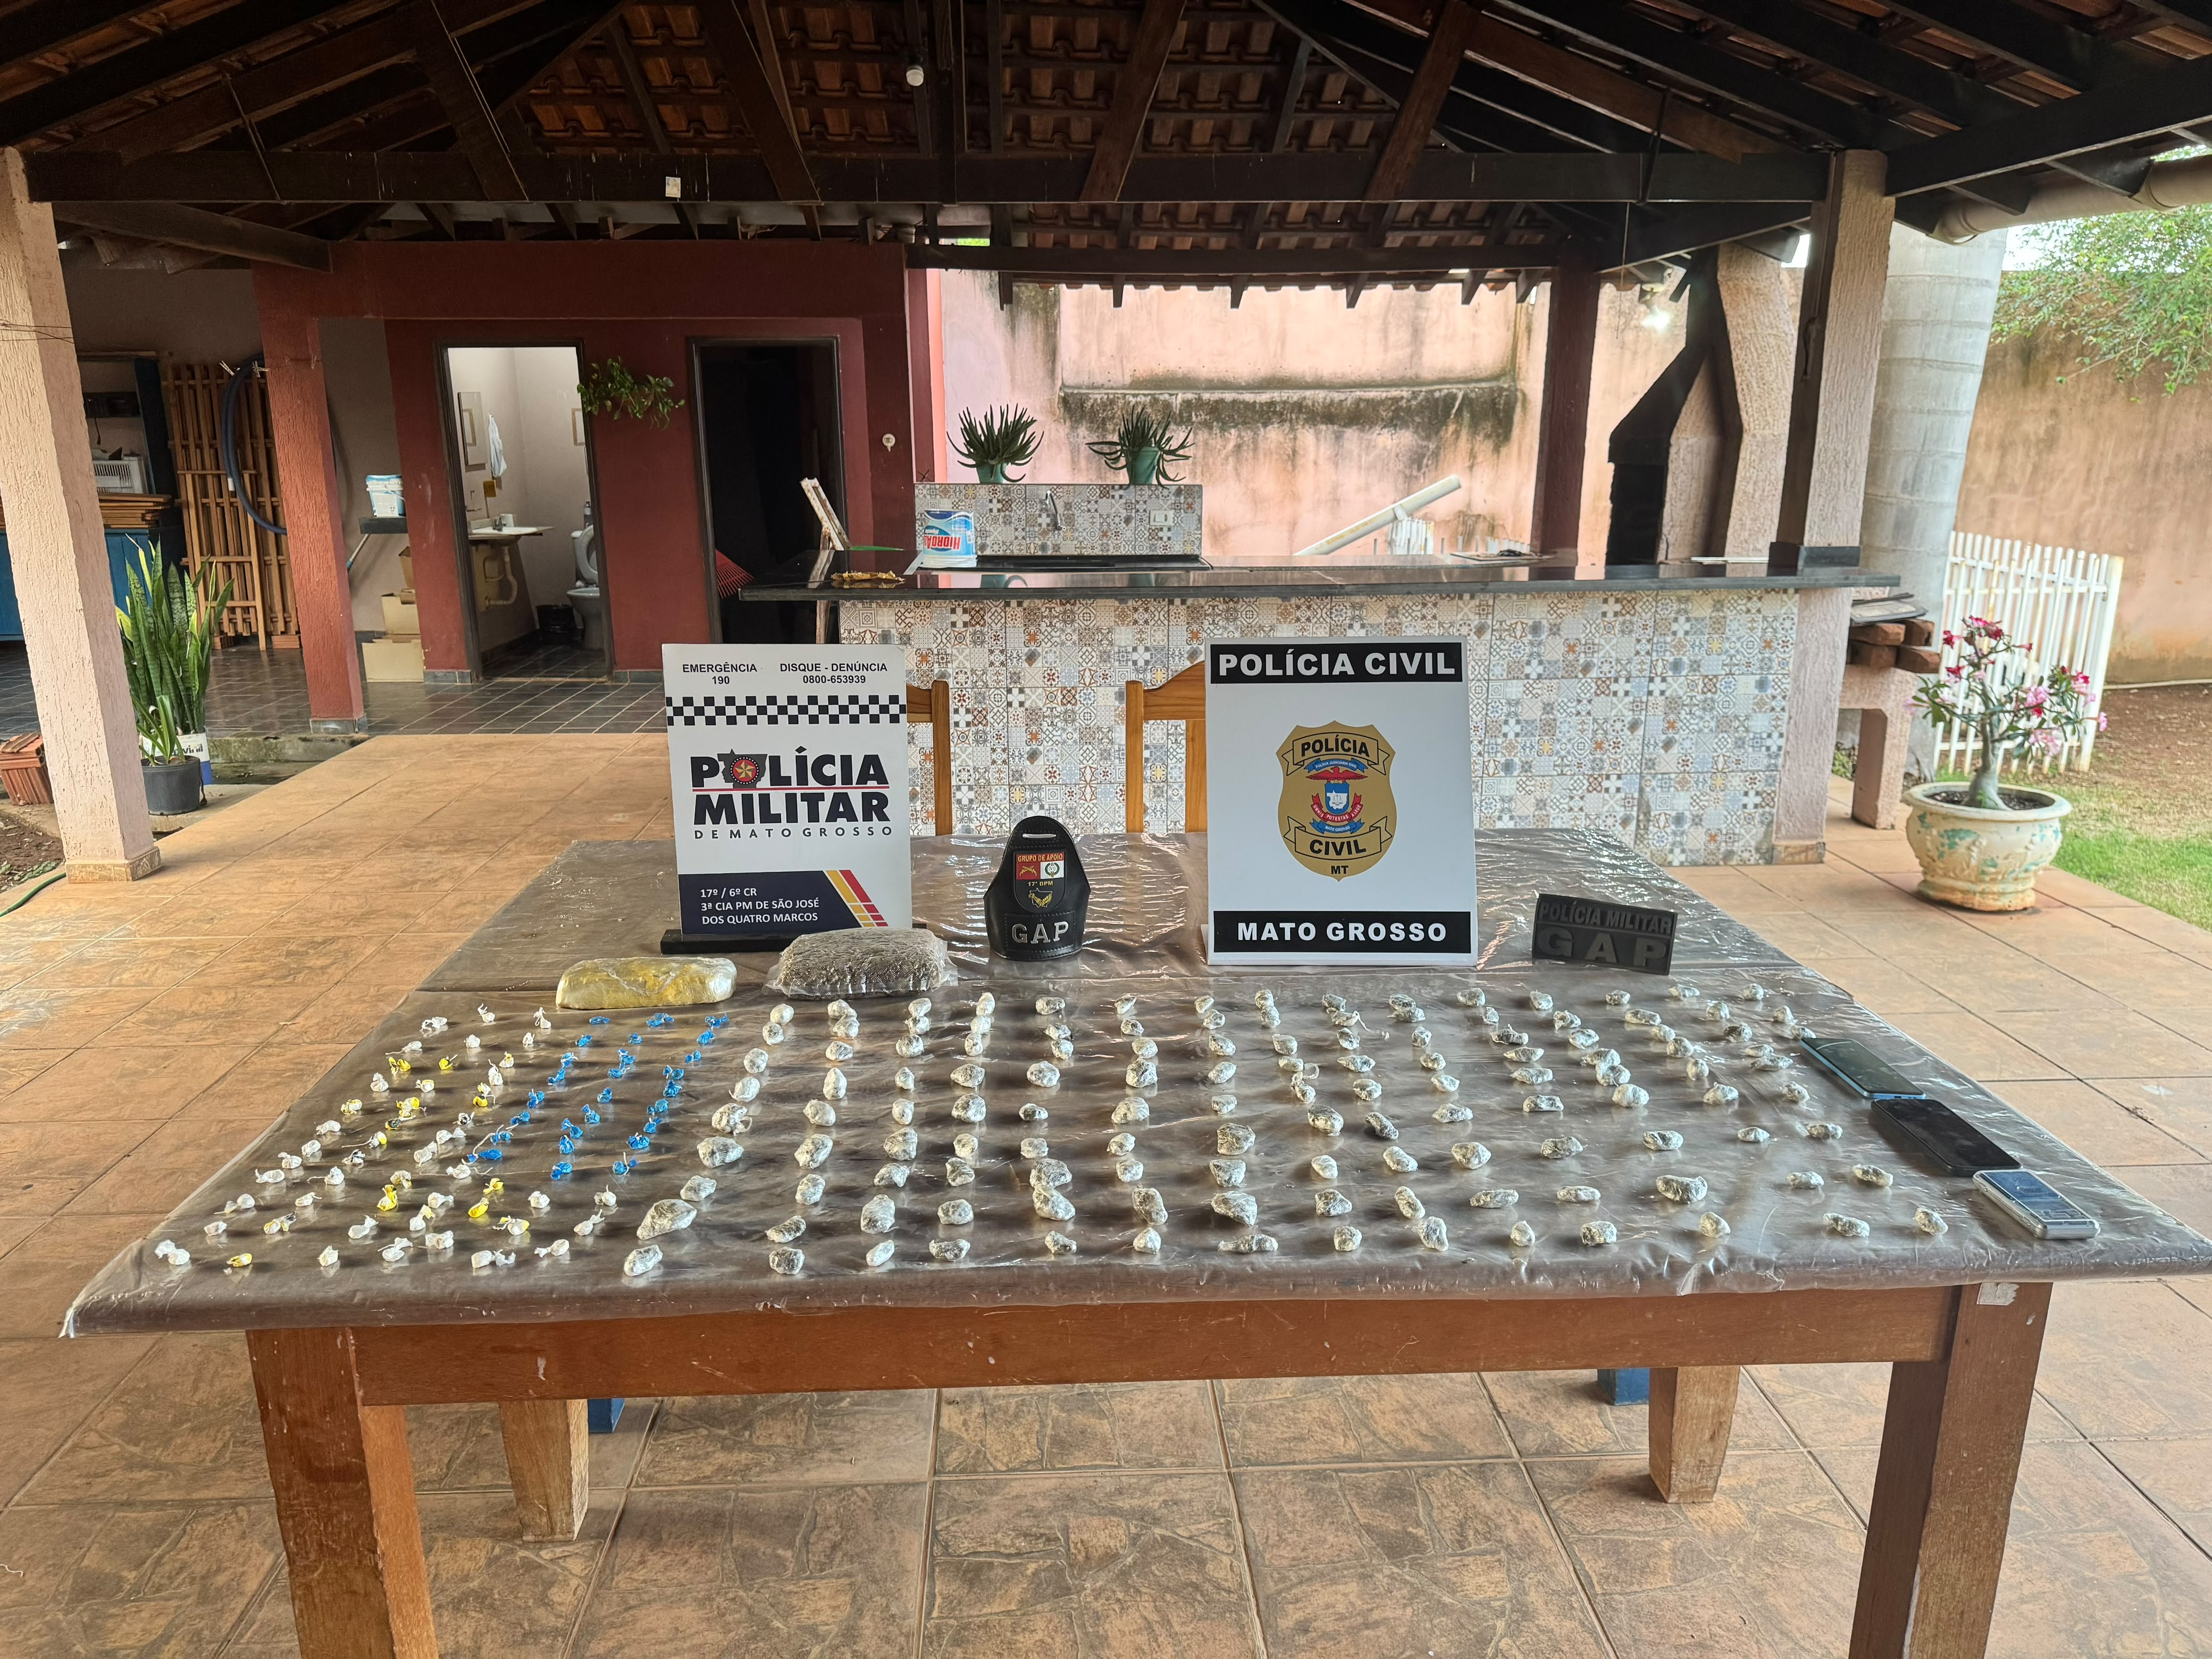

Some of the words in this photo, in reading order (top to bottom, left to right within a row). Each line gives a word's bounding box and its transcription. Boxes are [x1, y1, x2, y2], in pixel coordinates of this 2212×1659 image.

[682, 662, 757, 673] EMERGÊNCIA
[780, 663, 822, 672] DISQUE
[831, 661, 887, 672] DENÚNCIA
[1219, 649, 1355, 676] POLÍCIA
[1364, 652, 1455, 674] CIVIL
[711, 676, 730, 685] 190
[802, 675, 866, 684] 0800-653939
[1301, 734, 1370, 757] POLÍCIA
[694, 792, 890, 825] MILITAR
[1313, 805, 1324, 818] OMNIS
[694, 830, 718, 839] DE
[730, 828, 791, 839] MATO
[802, 826, 892, 837] GROSSO
[1310, 839, 1367, 856] CIVIL
[1331, 866, 1348, 875] MT
[721, 887, 726, 899] /
[743, 888, 757, 896] CR
[736, 901, 752, 910] PM
[756, 901, 769, 909] DE
[772, 899, 793, 909] SÃO
[795, 898, 819, 908] JOSÉ
[702, 916, 724, 925] DOS
[727, 914, 770, 925] QUATRO
[773, 912, 818, 922] MARCOS
[1538, 901, 1602, 926] POLÍCIA
[1605, 910, 1672, 934] MILITAR
[1011, 921, 1069, 944] GAP
[1238, 923, 1316, 941] MATO
[1327, 923, 1447, 942] GROSSO
[1537, 926, 1666, 966] GAP
